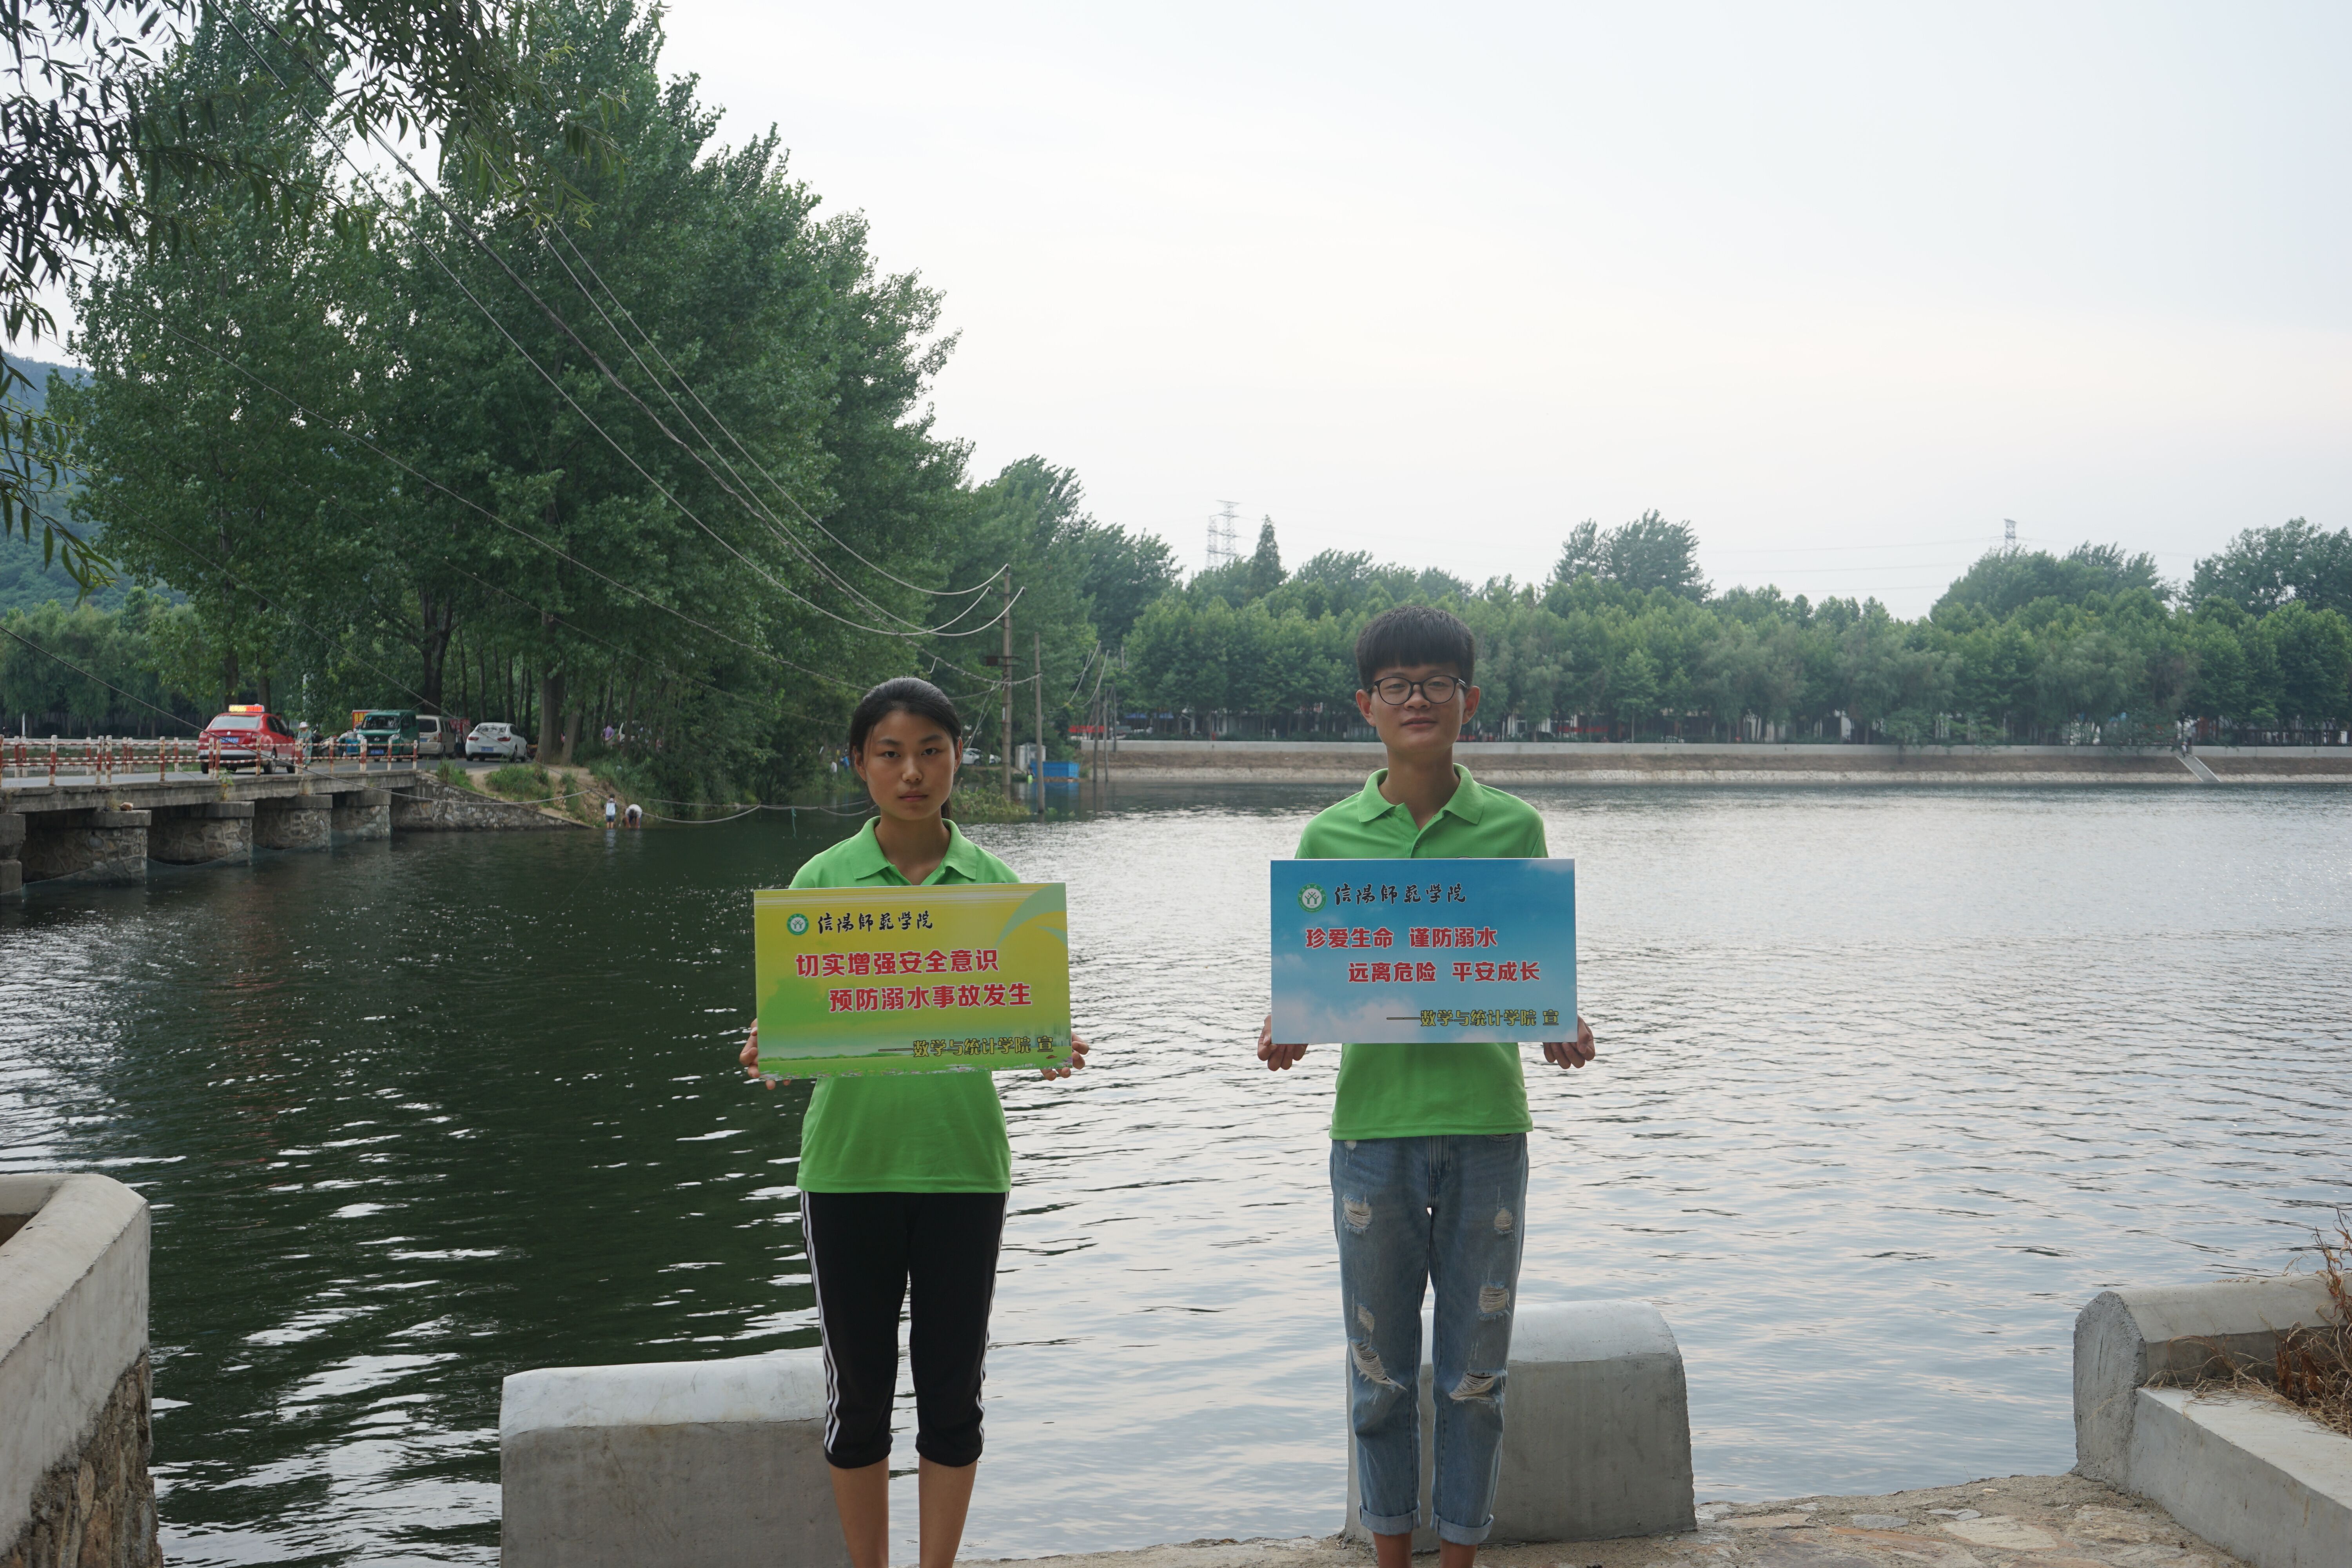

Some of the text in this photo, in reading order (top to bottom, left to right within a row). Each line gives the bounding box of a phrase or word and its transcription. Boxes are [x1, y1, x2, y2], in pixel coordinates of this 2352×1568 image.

[1306, 926, 1497, 949] 珍爱生命 谨防溺水
[796, 949, 999, 978] 切实增强安全意识
[1348, 961, 1541, 983] 远离危险 平安成长
[829, 983, 1032, 1013] 预防溺水事故发生
[1543, 1009, 1559, 1026] 宣
[1037, 1036, 1054, 1052] 宣
